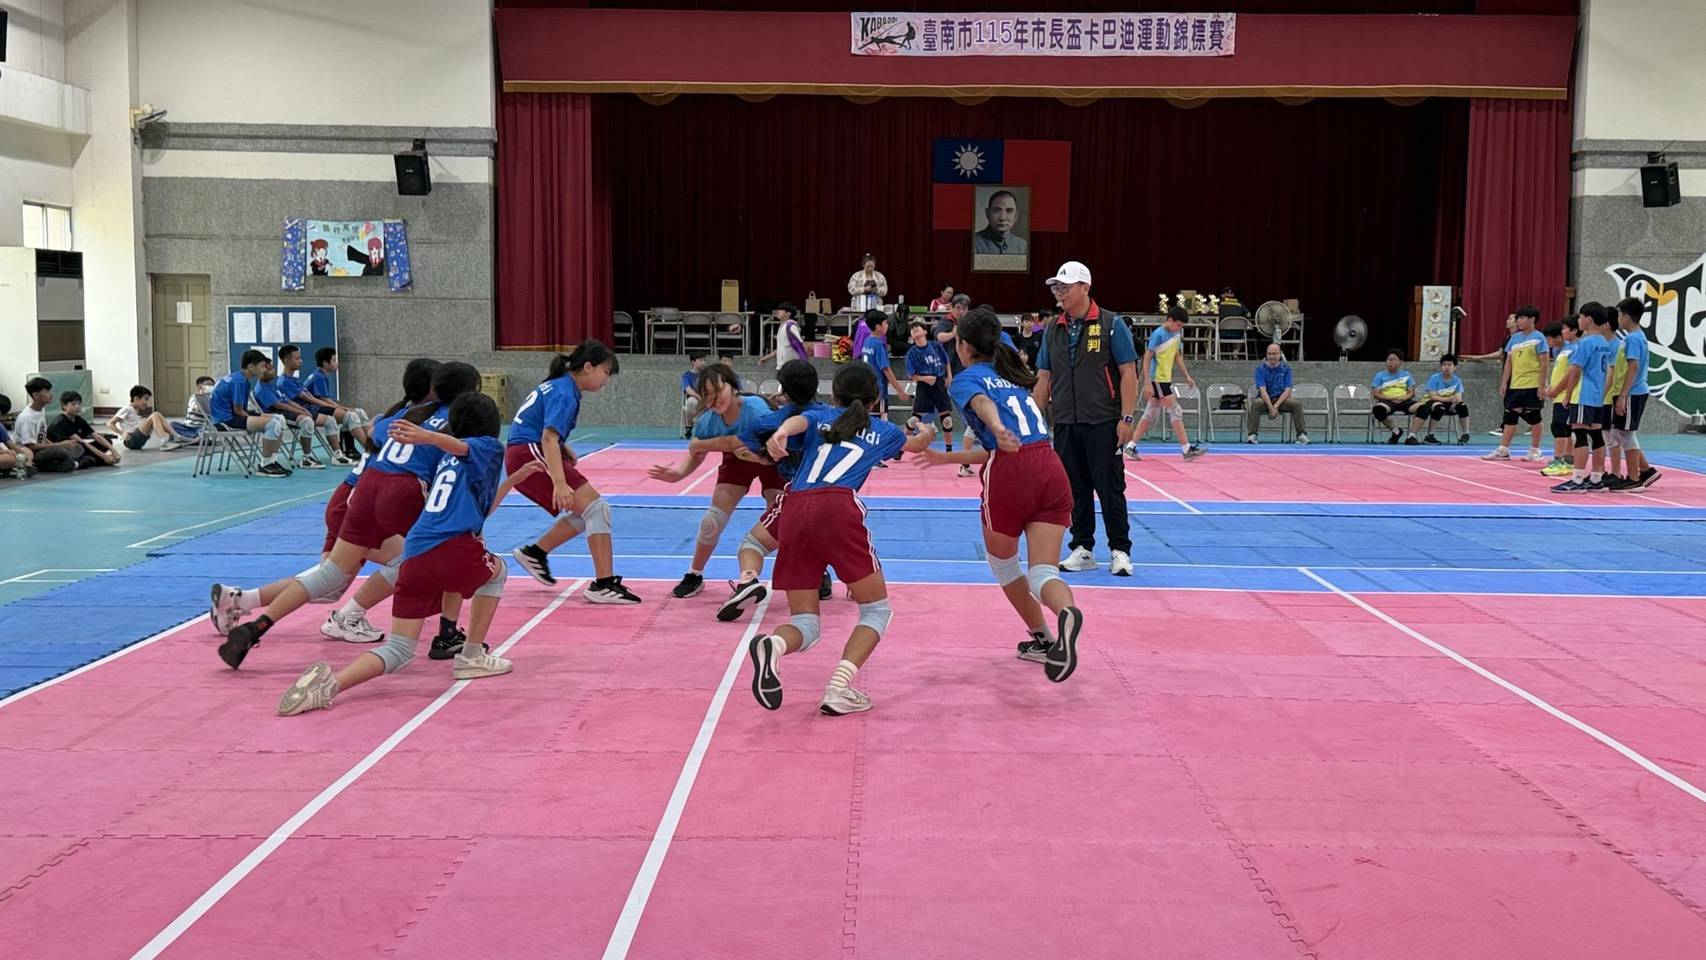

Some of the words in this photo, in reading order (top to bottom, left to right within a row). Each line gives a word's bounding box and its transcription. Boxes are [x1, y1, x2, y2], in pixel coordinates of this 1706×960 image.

[859, 16, 898, 42] KABADDI
[922, 17, 1225, 51] 臺南市115年市長盃卡巴迪運動錦標賽
[1087, 323, 1102, 353] 裁判
[1006, 395, 1047, 436] 11
[806, 440, 864, 484] 17
[425, 469, 457, 513] 6
